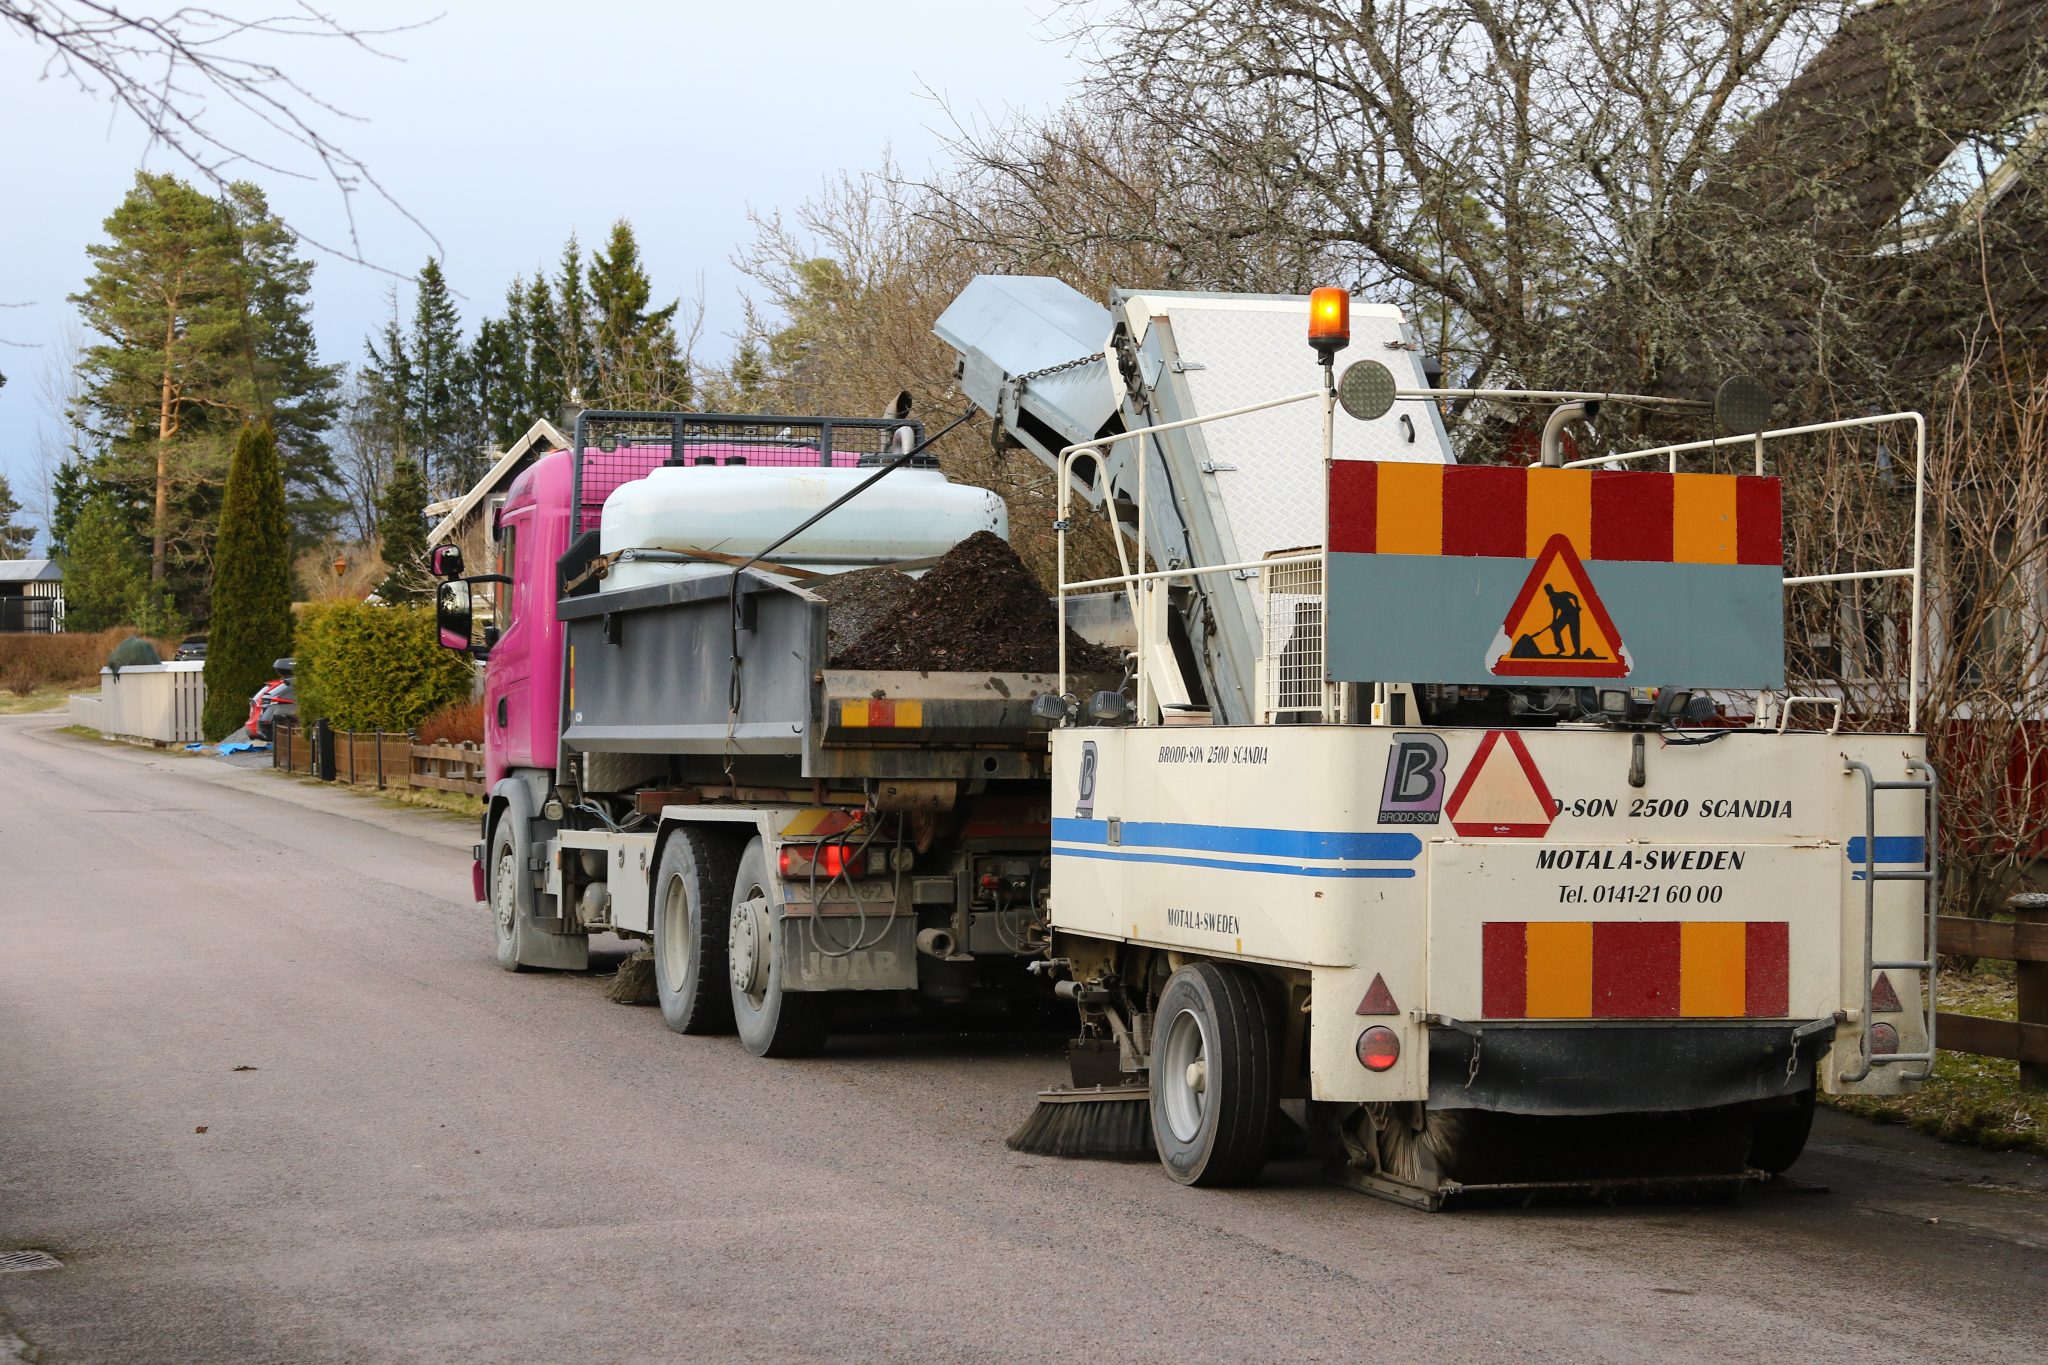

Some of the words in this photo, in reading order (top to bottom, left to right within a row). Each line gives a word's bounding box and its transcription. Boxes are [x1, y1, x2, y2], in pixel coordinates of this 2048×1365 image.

[1158, 746, 1204, 763] BRODD-SON
[1207, 746, 1230, 763] 2500
[1232, 746, 1268, 764] SCANDIA
[1379, 812, 1439, 822] BRODD-SON
[1628, 799, 1689, 818] 2500
[1700, 799, 1793, 819] SCANDIA
[1536, 850, 1746, 870] MOTALA-SWEDEN
[1558, 885, 1588, 903] Tel.
[1592, 885, 1660, 903] 0141-21
[1666, 885, 1692, 903] 60
[1697, 885, 1723, 903] 00
[1167, 908, 1240, 934] MOTALA-SWEDEN
[802, 951, 899, 981] JOAB
